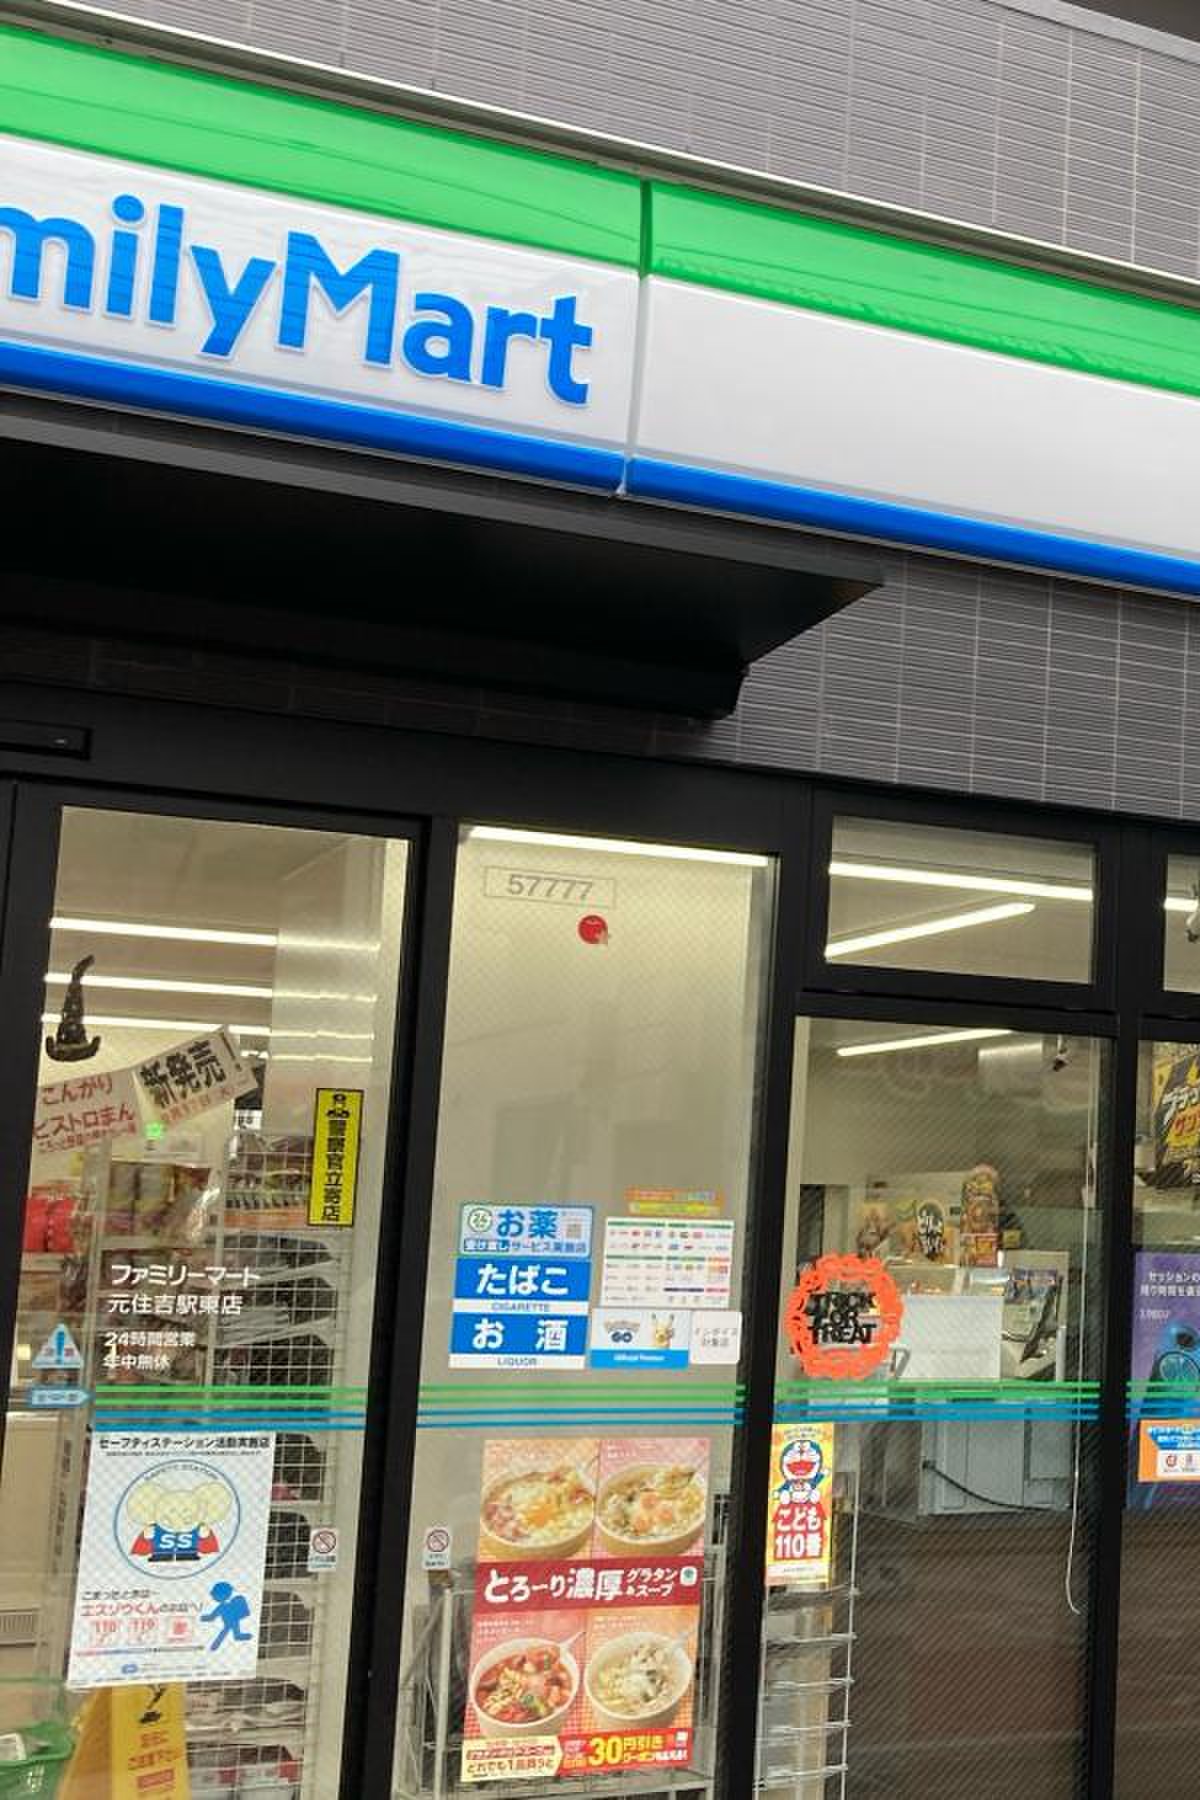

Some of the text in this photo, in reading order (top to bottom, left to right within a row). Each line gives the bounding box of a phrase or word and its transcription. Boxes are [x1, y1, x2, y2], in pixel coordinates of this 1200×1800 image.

[508, 874, 593, 899] 57777
[497, 1209, 557, 1239] お薬
[111, 1264, 261, 1287] ファミリーマート
[476, 1263, 569, 1295] たばこ
[108, 1294, 243, 1315] 元住吉駅東店
[491, 1302, 551, 1312] CIGARETTE
[103, 1331, 196, 1347] 24時間営業
[103, 1354, 170, 1371] 年中無休
[497, 1356, 538, 1367] LIQUOR
[777, 1508, 822, 1531] こども
[159, 1533, 192, 1549] SS
[484, 1568, 624, 1602] とろーり濃厚
[626, 1567, 678, 1582] グラタン
